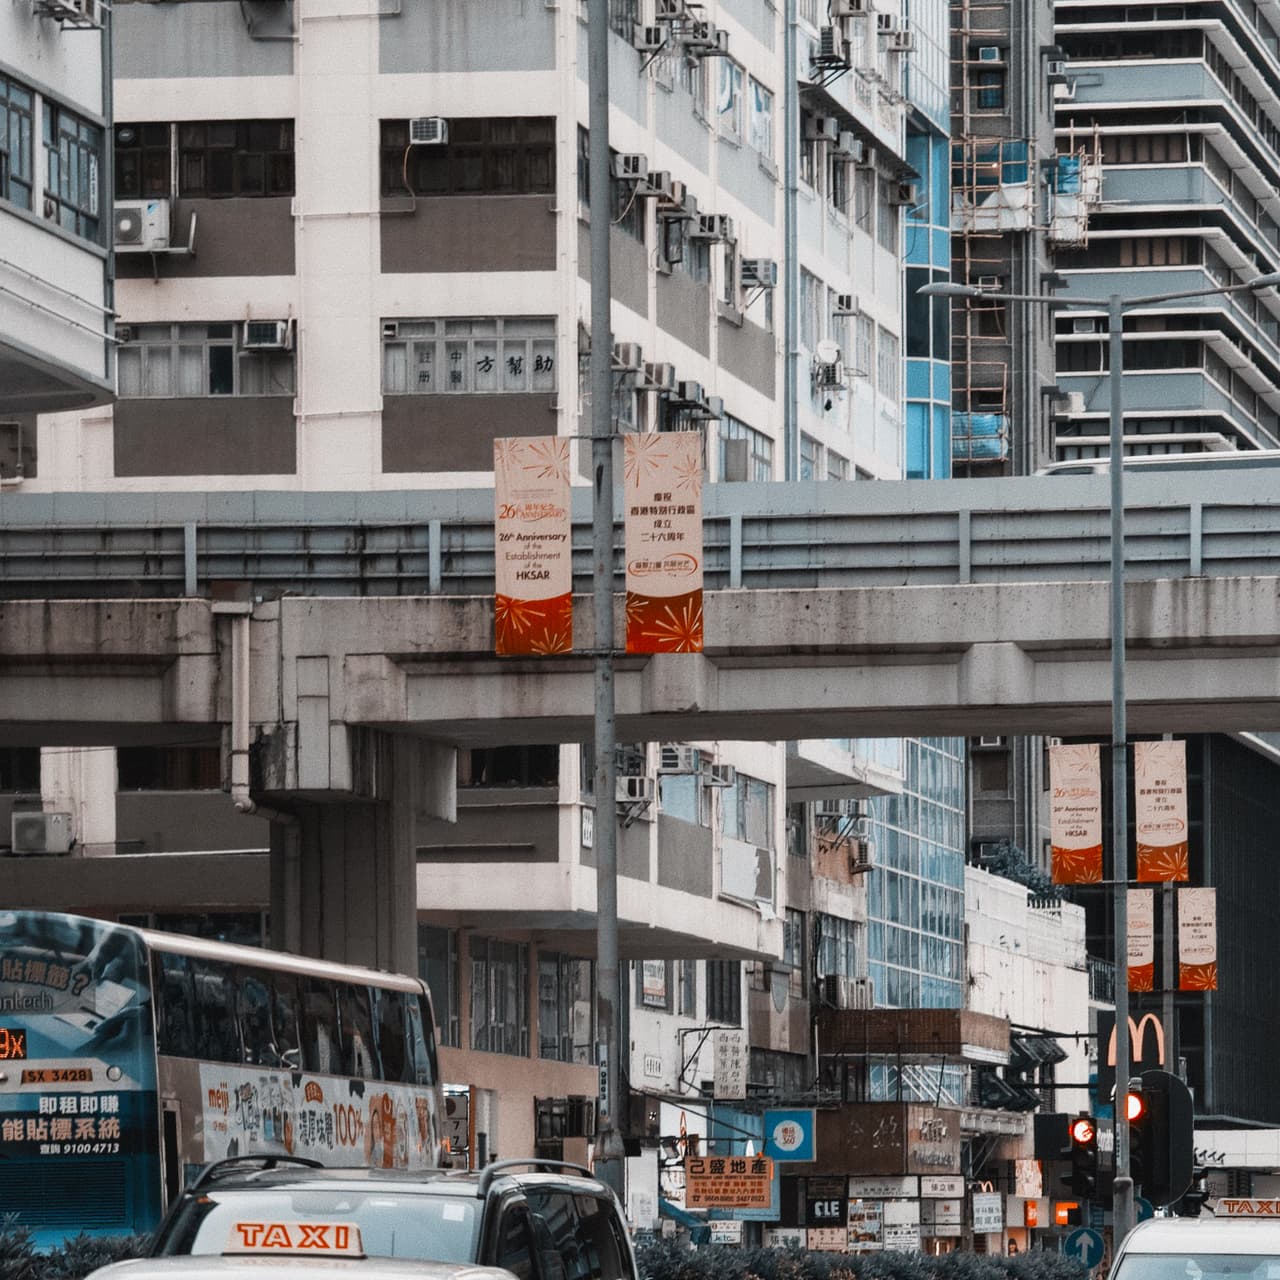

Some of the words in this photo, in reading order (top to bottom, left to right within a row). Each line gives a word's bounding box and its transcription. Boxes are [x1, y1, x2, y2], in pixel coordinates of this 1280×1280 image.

[516, 531, 567, 544] Anniversary
[505, 552, 561, 561] Establishment
[516, 571, 550, 580] HKSAR
[27, 1069, 45, 1082] SX
[53, 1069, 87, 1082] 3428
[39, 1095, 119, 1115] 即租即賺
[208, 1082, 229, 1116] meiji
[63, 1143, 91, 1155] 9100
[92, 1143, 120, 1155] 4713
[236, 1222, 351, 1250] TAXI
